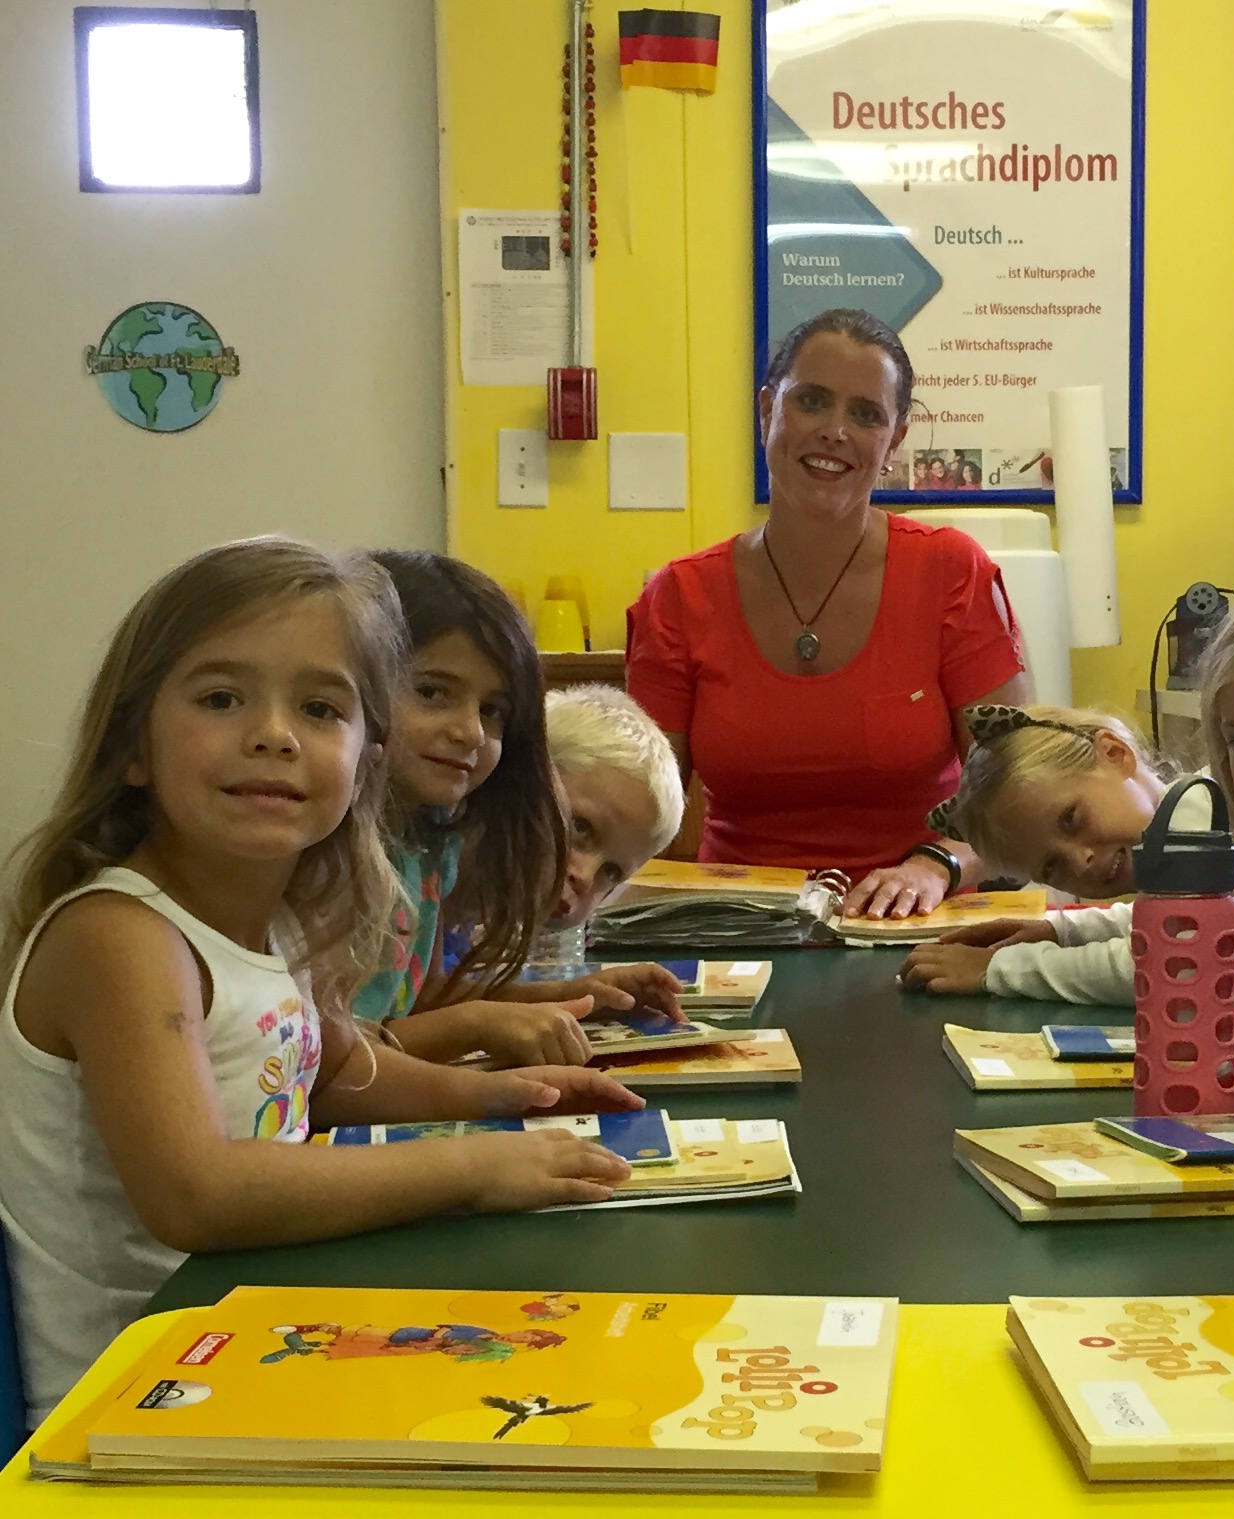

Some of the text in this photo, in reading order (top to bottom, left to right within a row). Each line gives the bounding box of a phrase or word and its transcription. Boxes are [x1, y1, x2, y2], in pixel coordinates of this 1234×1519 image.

[832, 91, 1006, 131] Deutsches
[934, 225, 1002, 245] Deutsch
[782, 253, 840, 267] Warum
[782, 272, 905, 287] Deutsch lernen?
[1008, 267, 1021, 279] ist
[1023, 266, 1096, 281] Kultursprache
[975, 303, 987, 315] ist
[989, 302, 1102, 318] Wissenschaftssprache
[940, 339, 953, 351] ist
[955, 338, 1053, 354] Wirtschaftssprache
[943, 375, 970, 389] jeder
[972, 374, 982, 386] 5.
[984, 373, 1037, 389] EU-Bürger
[910, 410, 984, 423] mehr Chancen
[641, 1302, 667, 1321] Fibel
